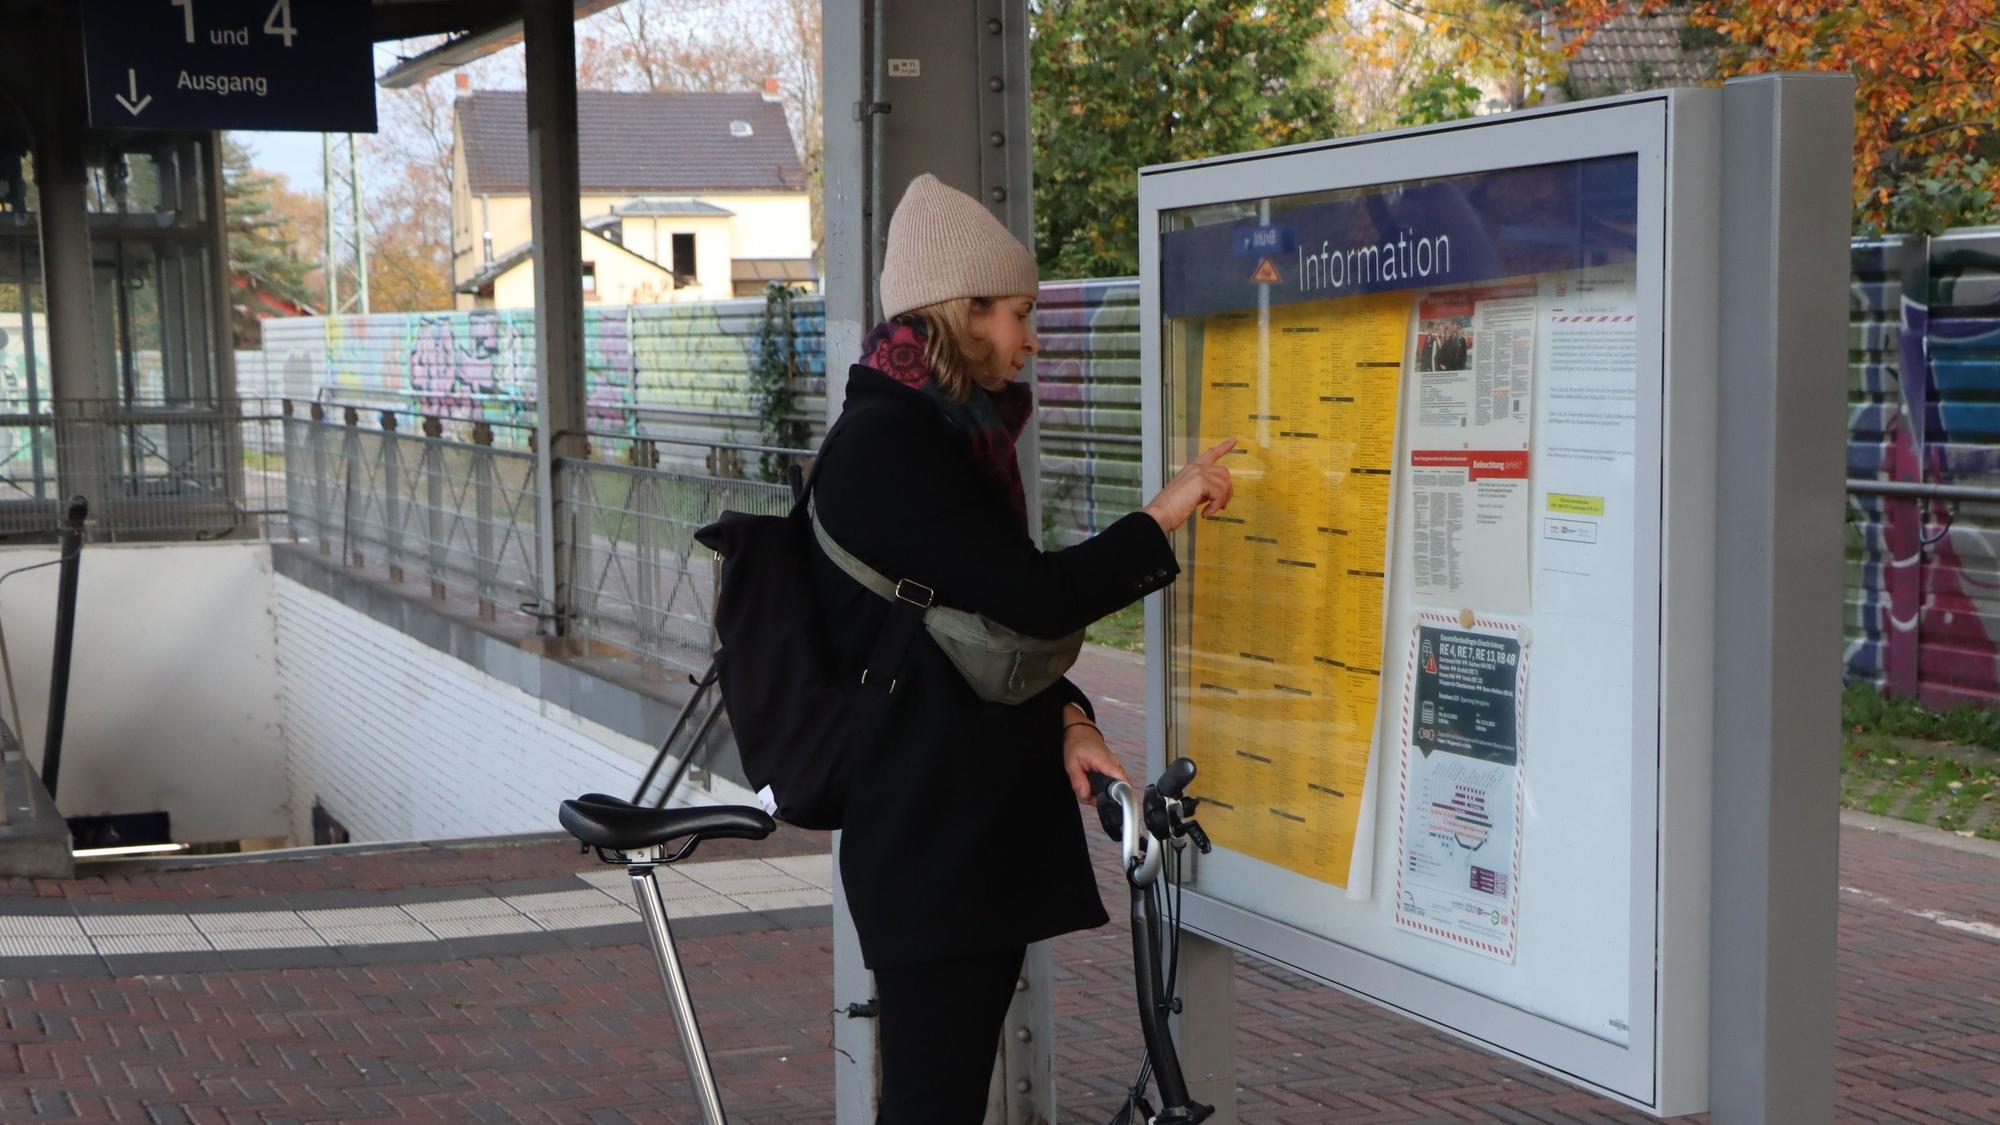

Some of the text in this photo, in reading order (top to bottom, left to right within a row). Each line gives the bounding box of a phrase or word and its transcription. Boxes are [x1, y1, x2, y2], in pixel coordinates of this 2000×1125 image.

[171, 0, 298, 47] 1 und 4
[177, 70, 268, 97] Ausgang
[1298, 227, 1450, 292] Information
[1472, 460, 1505, 471] Beleuchtung
[1440, 643, 1516, 666] RE 4, RE 7, RE 13, RB 48
